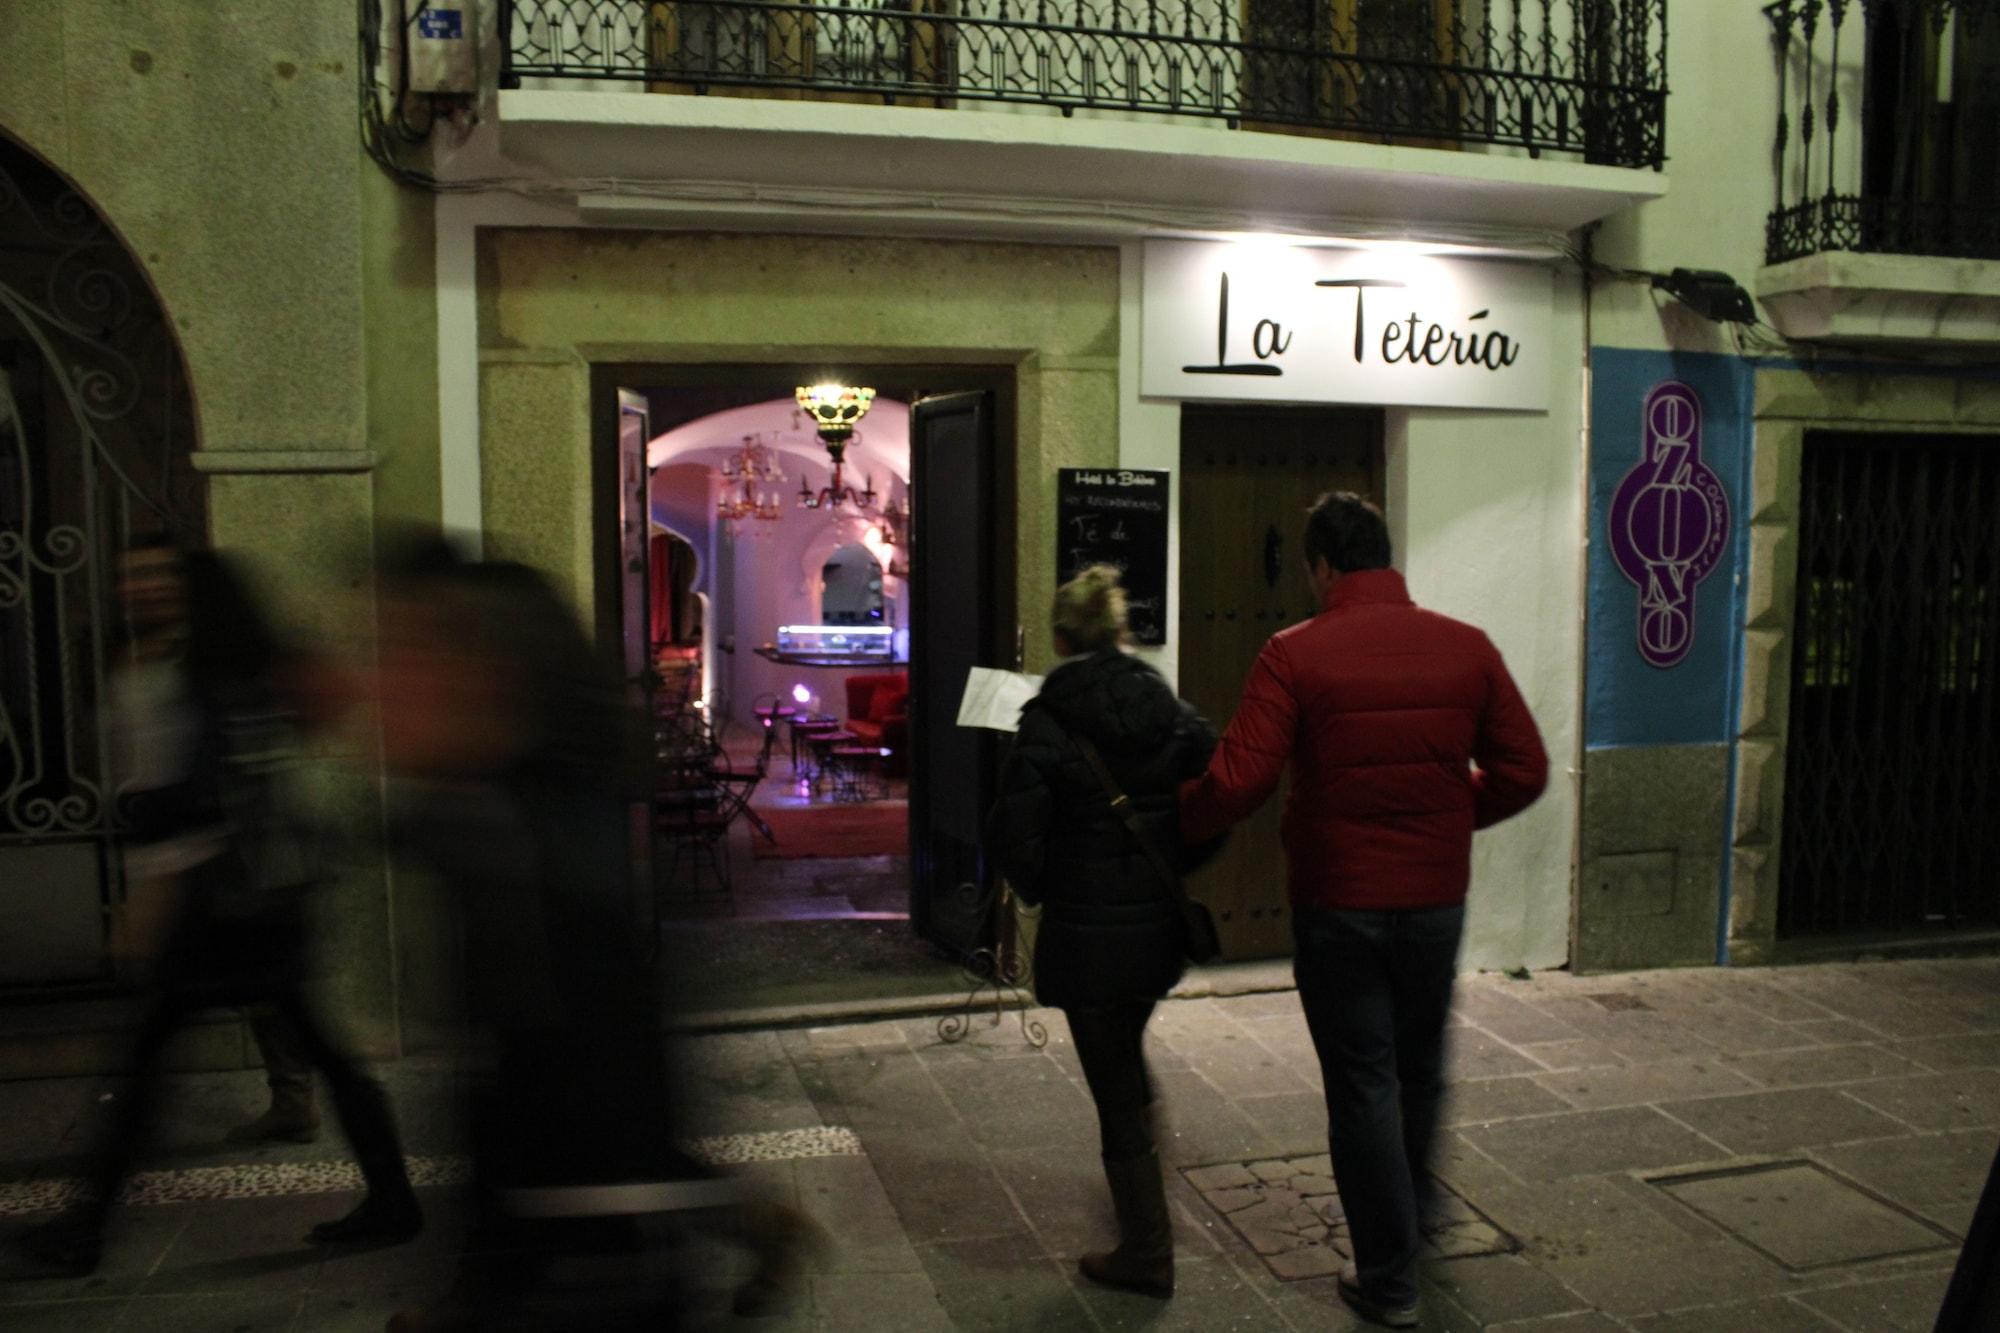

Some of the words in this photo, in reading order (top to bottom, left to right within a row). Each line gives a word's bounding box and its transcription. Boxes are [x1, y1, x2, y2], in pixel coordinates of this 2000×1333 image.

[1182, 271, 1292, 376] La
[1315, 278, 1520, 371] Tetería
[1627, 394, 1712, 654] OZONO
